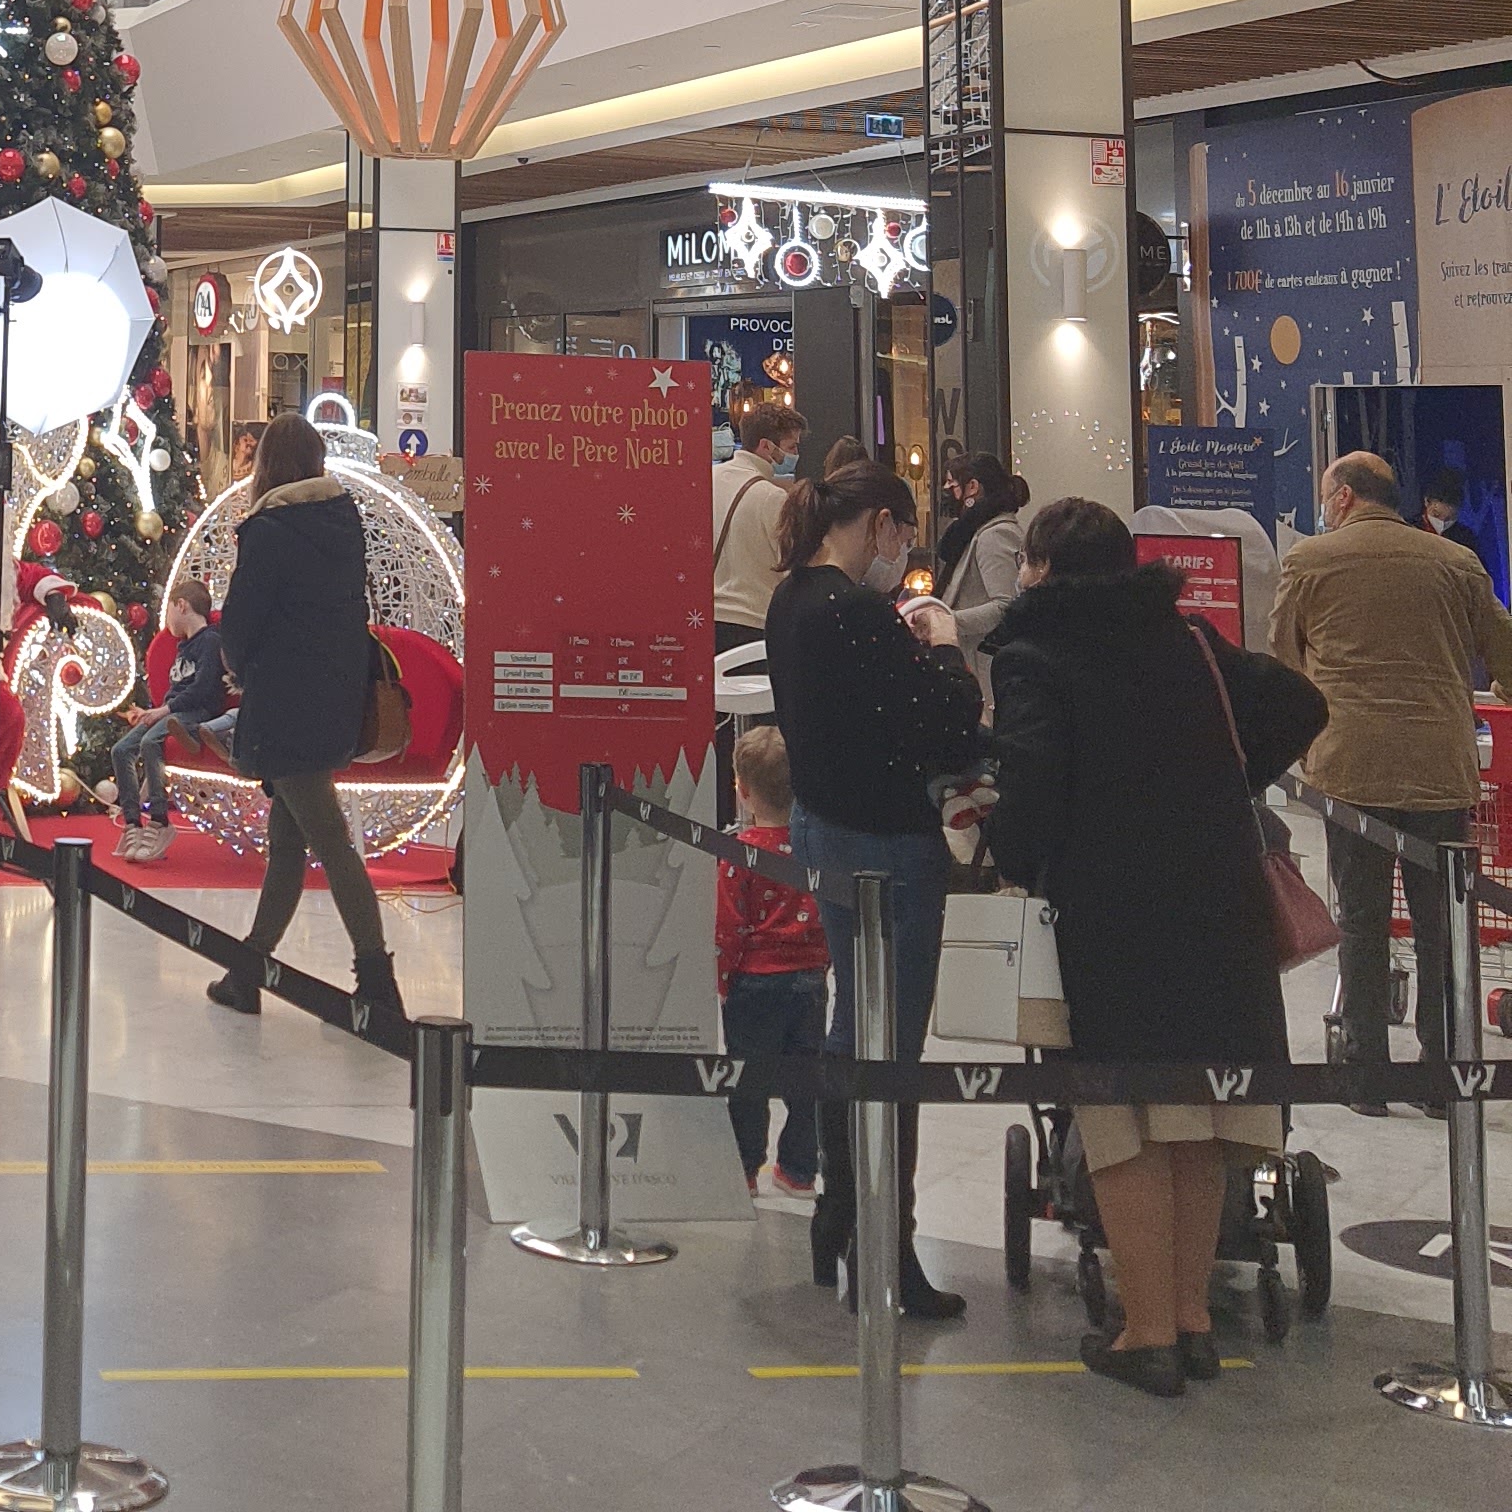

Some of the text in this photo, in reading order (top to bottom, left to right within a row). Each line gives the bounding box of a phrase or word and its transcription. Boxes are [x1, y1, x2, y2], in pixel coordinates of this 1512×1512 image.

[1236, 169, 1395, 208] du 5 décembre au 16 janvier
[1240, 205, 1387, 240] de 11h à 13h et de 14h à 19h
[1235, 269, 1262, 294] 700€
[1265, 274, 1275, 289] de
[1277, 271, 1303, 288] cartes
[1305, 270, 1338, 286] cadeaux
[1340, 267, 1348, 284] à
[1351, 266, 1394, 289] gagner
[1474, 258, 1488, 276] les
[1454, 294, 1464, 308] et
[491, 393, 689, 432] Prenez votre photo
[495, 434, 684, 469] avec le Père Noël !
